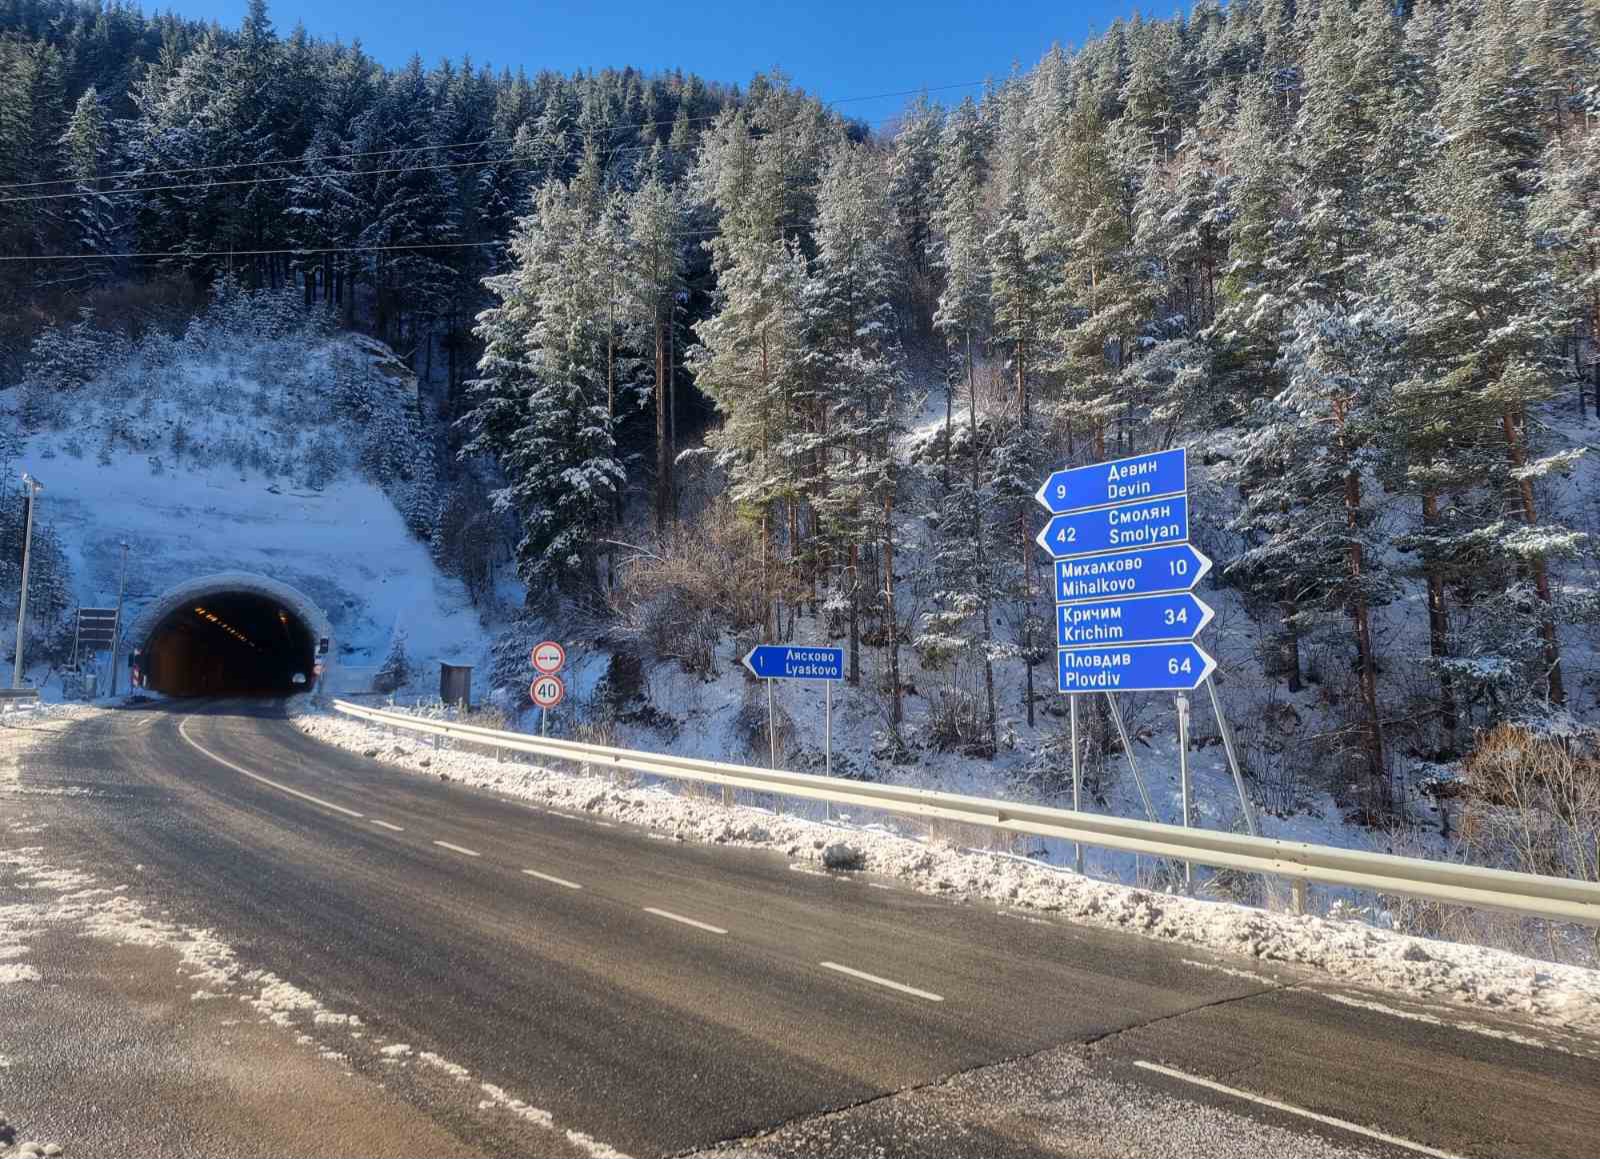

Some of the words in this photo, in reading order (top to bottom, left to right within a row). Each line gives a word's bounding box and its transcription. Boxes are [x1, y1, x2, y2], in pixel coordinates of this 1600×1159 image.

[1108, 460, 1158, 482] Девин
[1057, 485, 1066, 499] 9
[1108, 481, 1150, 499] Devin
[1109, 506, 1170, 525] Смолян
[1057, 527, 1076, 543] 42
[1109, 524, 1179, 544] Smolyan
[1062, 558, 1142, 577] Михалково
[1169, 559, 1188, 576] 10
[1063, 578, 1136, 596] Mihalkovo
[1063, 607, 1121, 625] Кричим
[1164, 608, 1188, 625] 34
[1064, 625, 1123, 641] Krichim
[760, 655, 763, 668] 1
[786, 649, 834, 662] Лясково
[1065, 653, 1131, 668] Пловдив
[785, 662, 837, 676] Lyaskovo
[1168, 658, 1192, 675] 64
[1065, 671, 1121, 687] Plovdiv
[538, 683, 556, 698] 40
